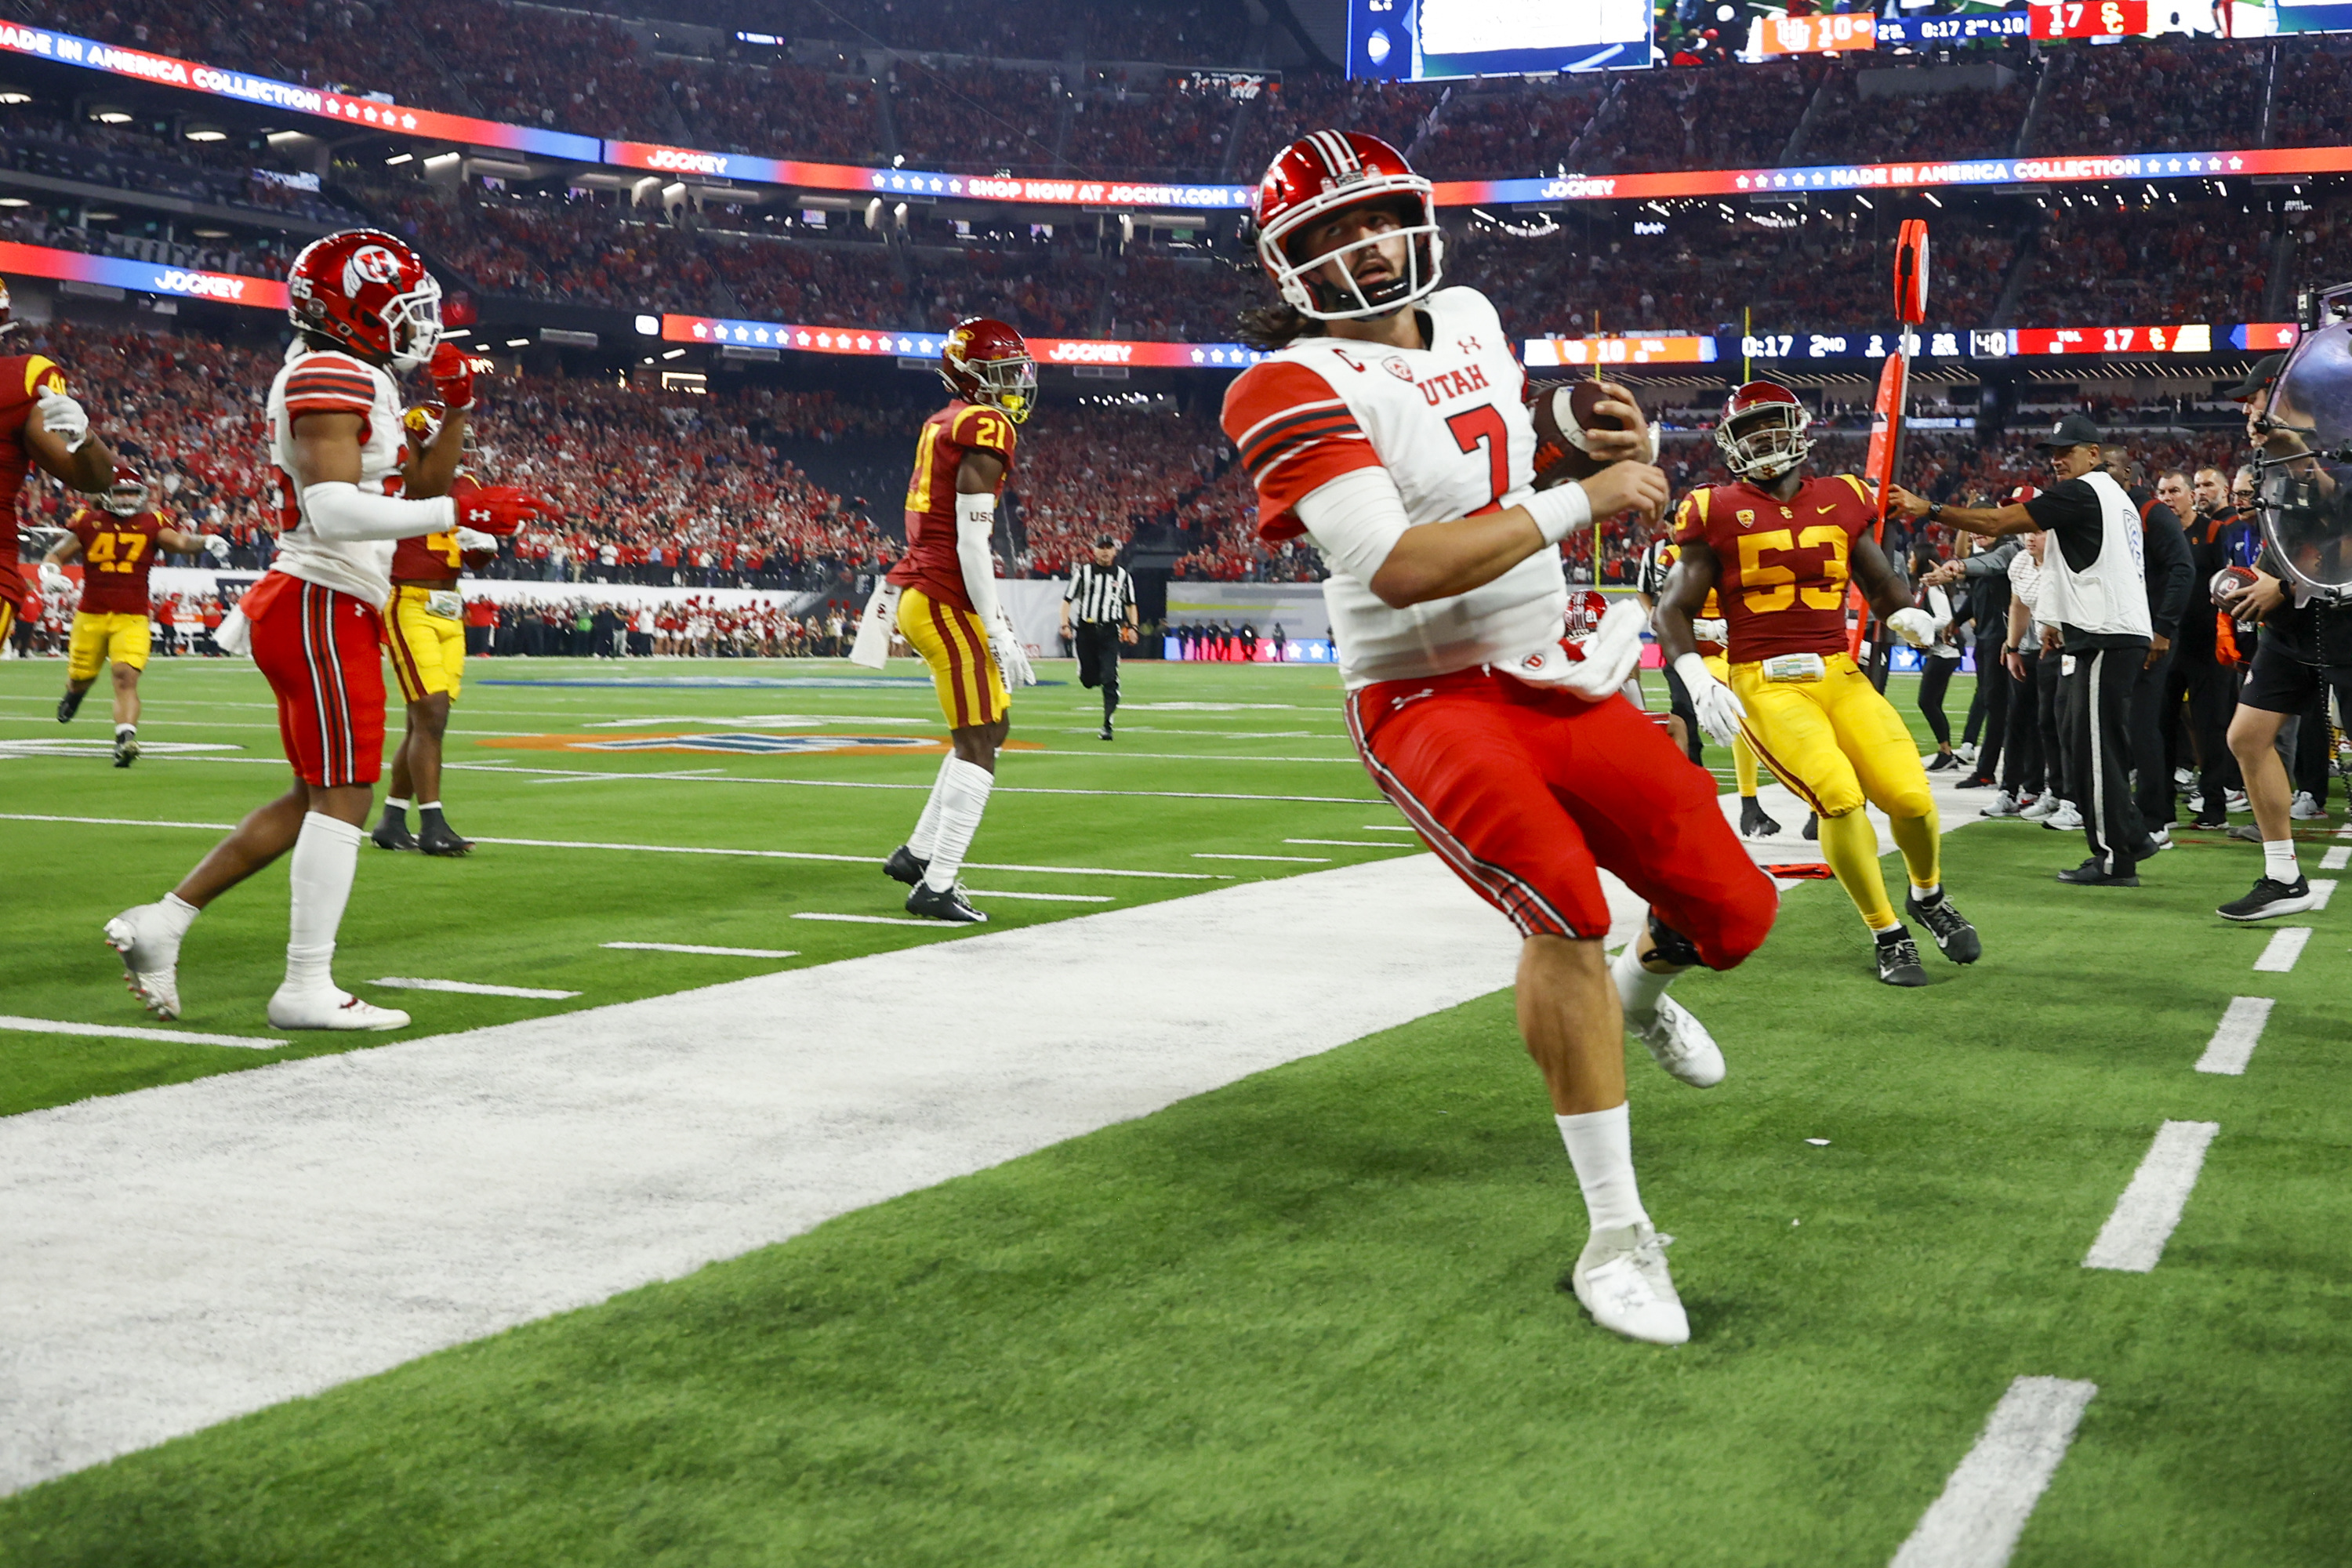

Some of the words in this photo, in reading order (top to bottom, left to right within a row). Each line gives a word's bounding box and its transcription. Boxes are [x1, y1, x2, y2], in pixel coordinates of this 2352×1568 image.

[1818, 16, 1851, 41] 10
[1922, 20, 1960, 38] 0:17
[2002, 17, 2024, 34] 10
[2049, 4, 2084, 28] 17
[0, 25, 53, 56] ADE
[56, 38, 83, 62] IN
[86, 45, 188, 85] AMERICA
[192, 67, 321, 112] COLLECTION
[647, 149, 728, 174] JOCKEY
[1831, 167, 1888, 186] MADE
[1891, 166, 1914, 183] IN
[1918, 162, 2009, 183] AMERICA
[2013, 158, 2141, 180] COLLECTION
[968, 179, 1022, 198] SHOP
[1025, 183, 1075, 200] NOW
[1078, 184, 1105, 201] AT
[1107, 185, 1229, 205] JOCKEY.COM
[1541, 179, 1616, 198] JOCKEY
[154, 269, 244, 299] JOCKEY
[1049, 342, 1132, 361] JOCKEY
[1741, 335, 1794, 358] 0:17
[1809, 335, 1846, 358] 2ND
[1976, 332, 2007, 356] 40
[2103, 328, 2135, 350] 17
[1416, 364, 1490, 406] UTAH
[975, 417, 1006, 449] 21
[1444, 402, 1510, 518] 7
[87, 532, 147, 574] 47
[1737, 524, 1849, 614] 53
